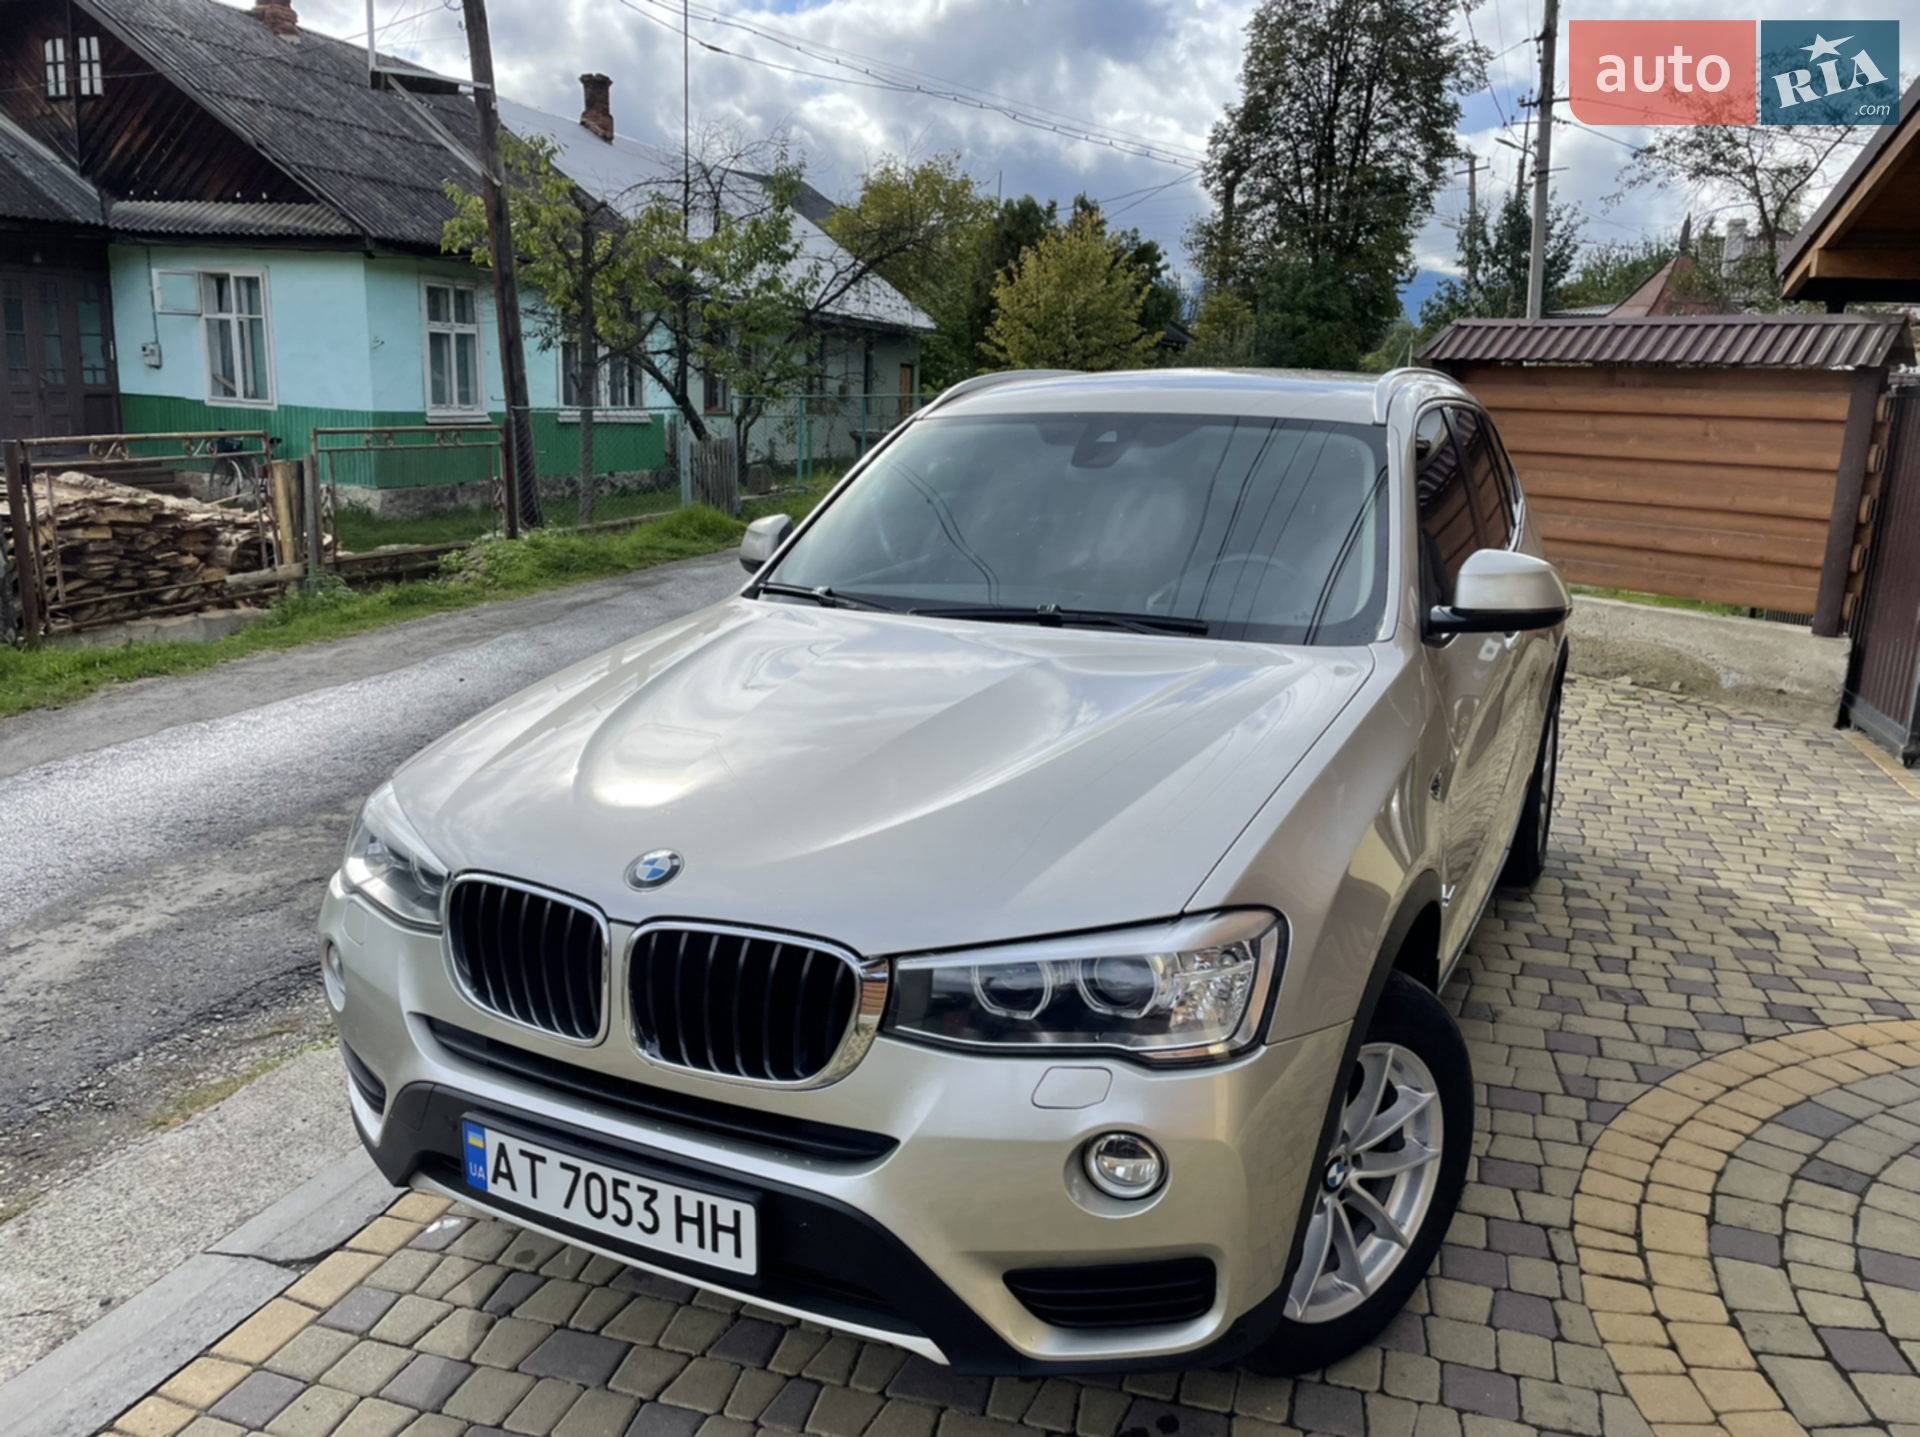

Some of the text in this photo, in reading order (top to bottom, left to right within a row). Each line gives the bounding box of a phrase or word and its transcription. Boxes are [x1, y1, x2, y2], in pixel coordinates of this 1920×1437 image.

[468, 1163, 486, 1180] UA
[491, 1142, 742, 1259] AT 7053 HH
